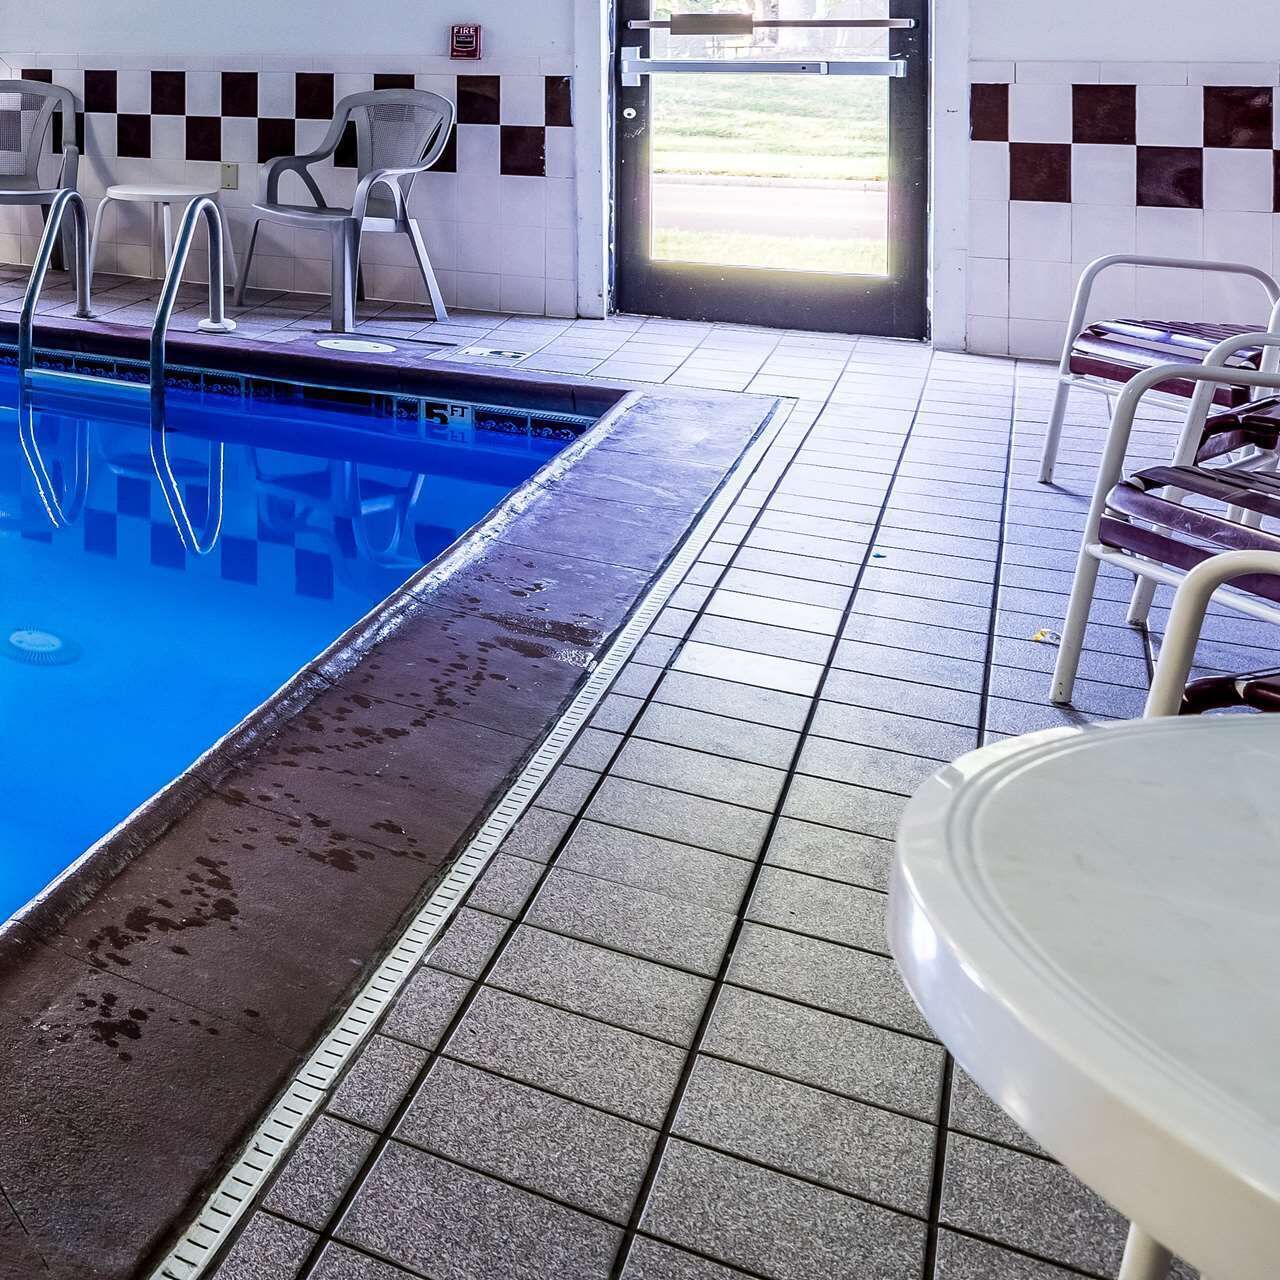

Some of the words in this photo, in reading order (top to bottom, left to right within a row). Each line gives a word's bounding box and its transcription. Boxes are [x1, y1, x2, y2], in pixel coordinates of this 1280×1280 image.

[454, 26, 476, 34] FIRE
[424, 401, 449, 424] 5
[450, 405, 469, 417] FT
